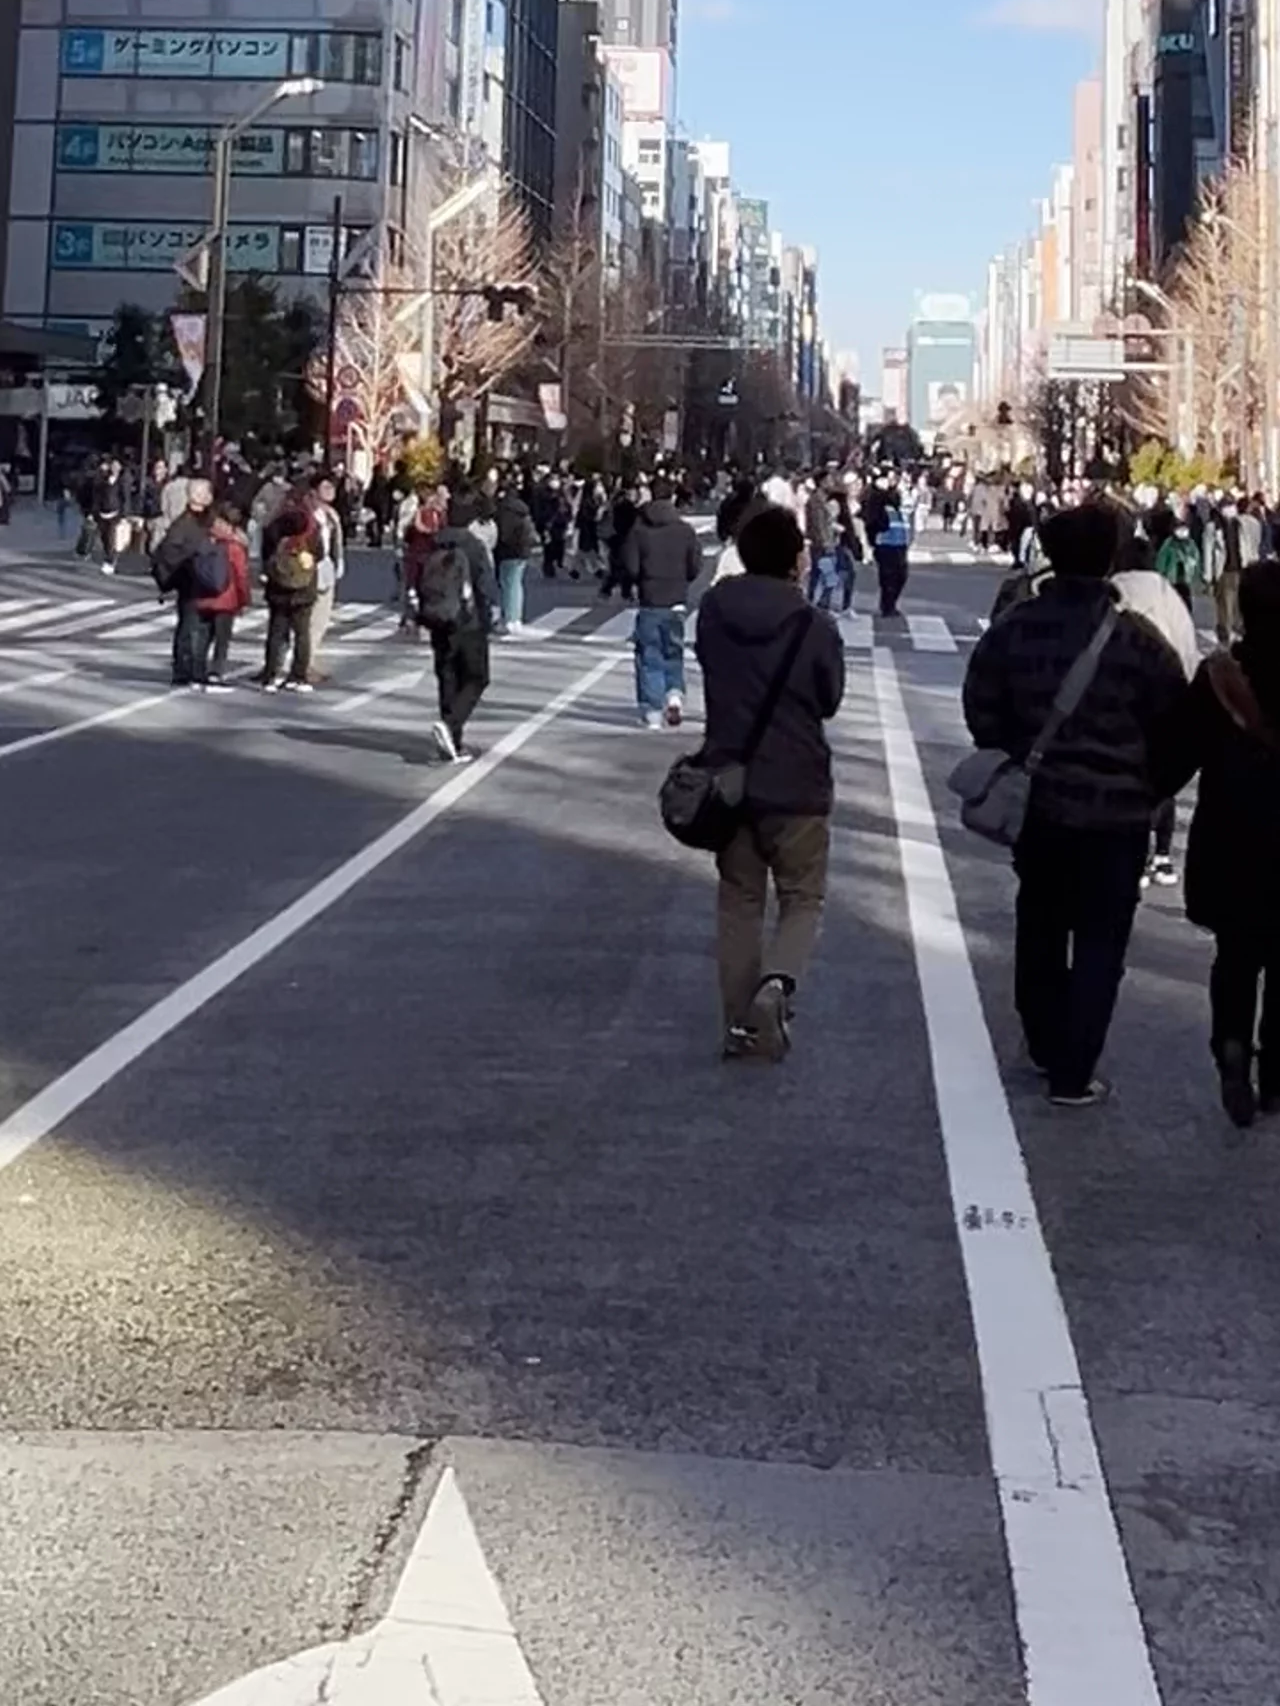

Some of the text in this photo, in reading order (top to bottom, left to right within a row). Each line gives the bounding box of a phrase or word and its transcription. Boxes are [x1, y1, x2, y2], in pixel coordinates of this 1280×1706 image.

[113, 37, 279, 57] ゲーミングパソコン
